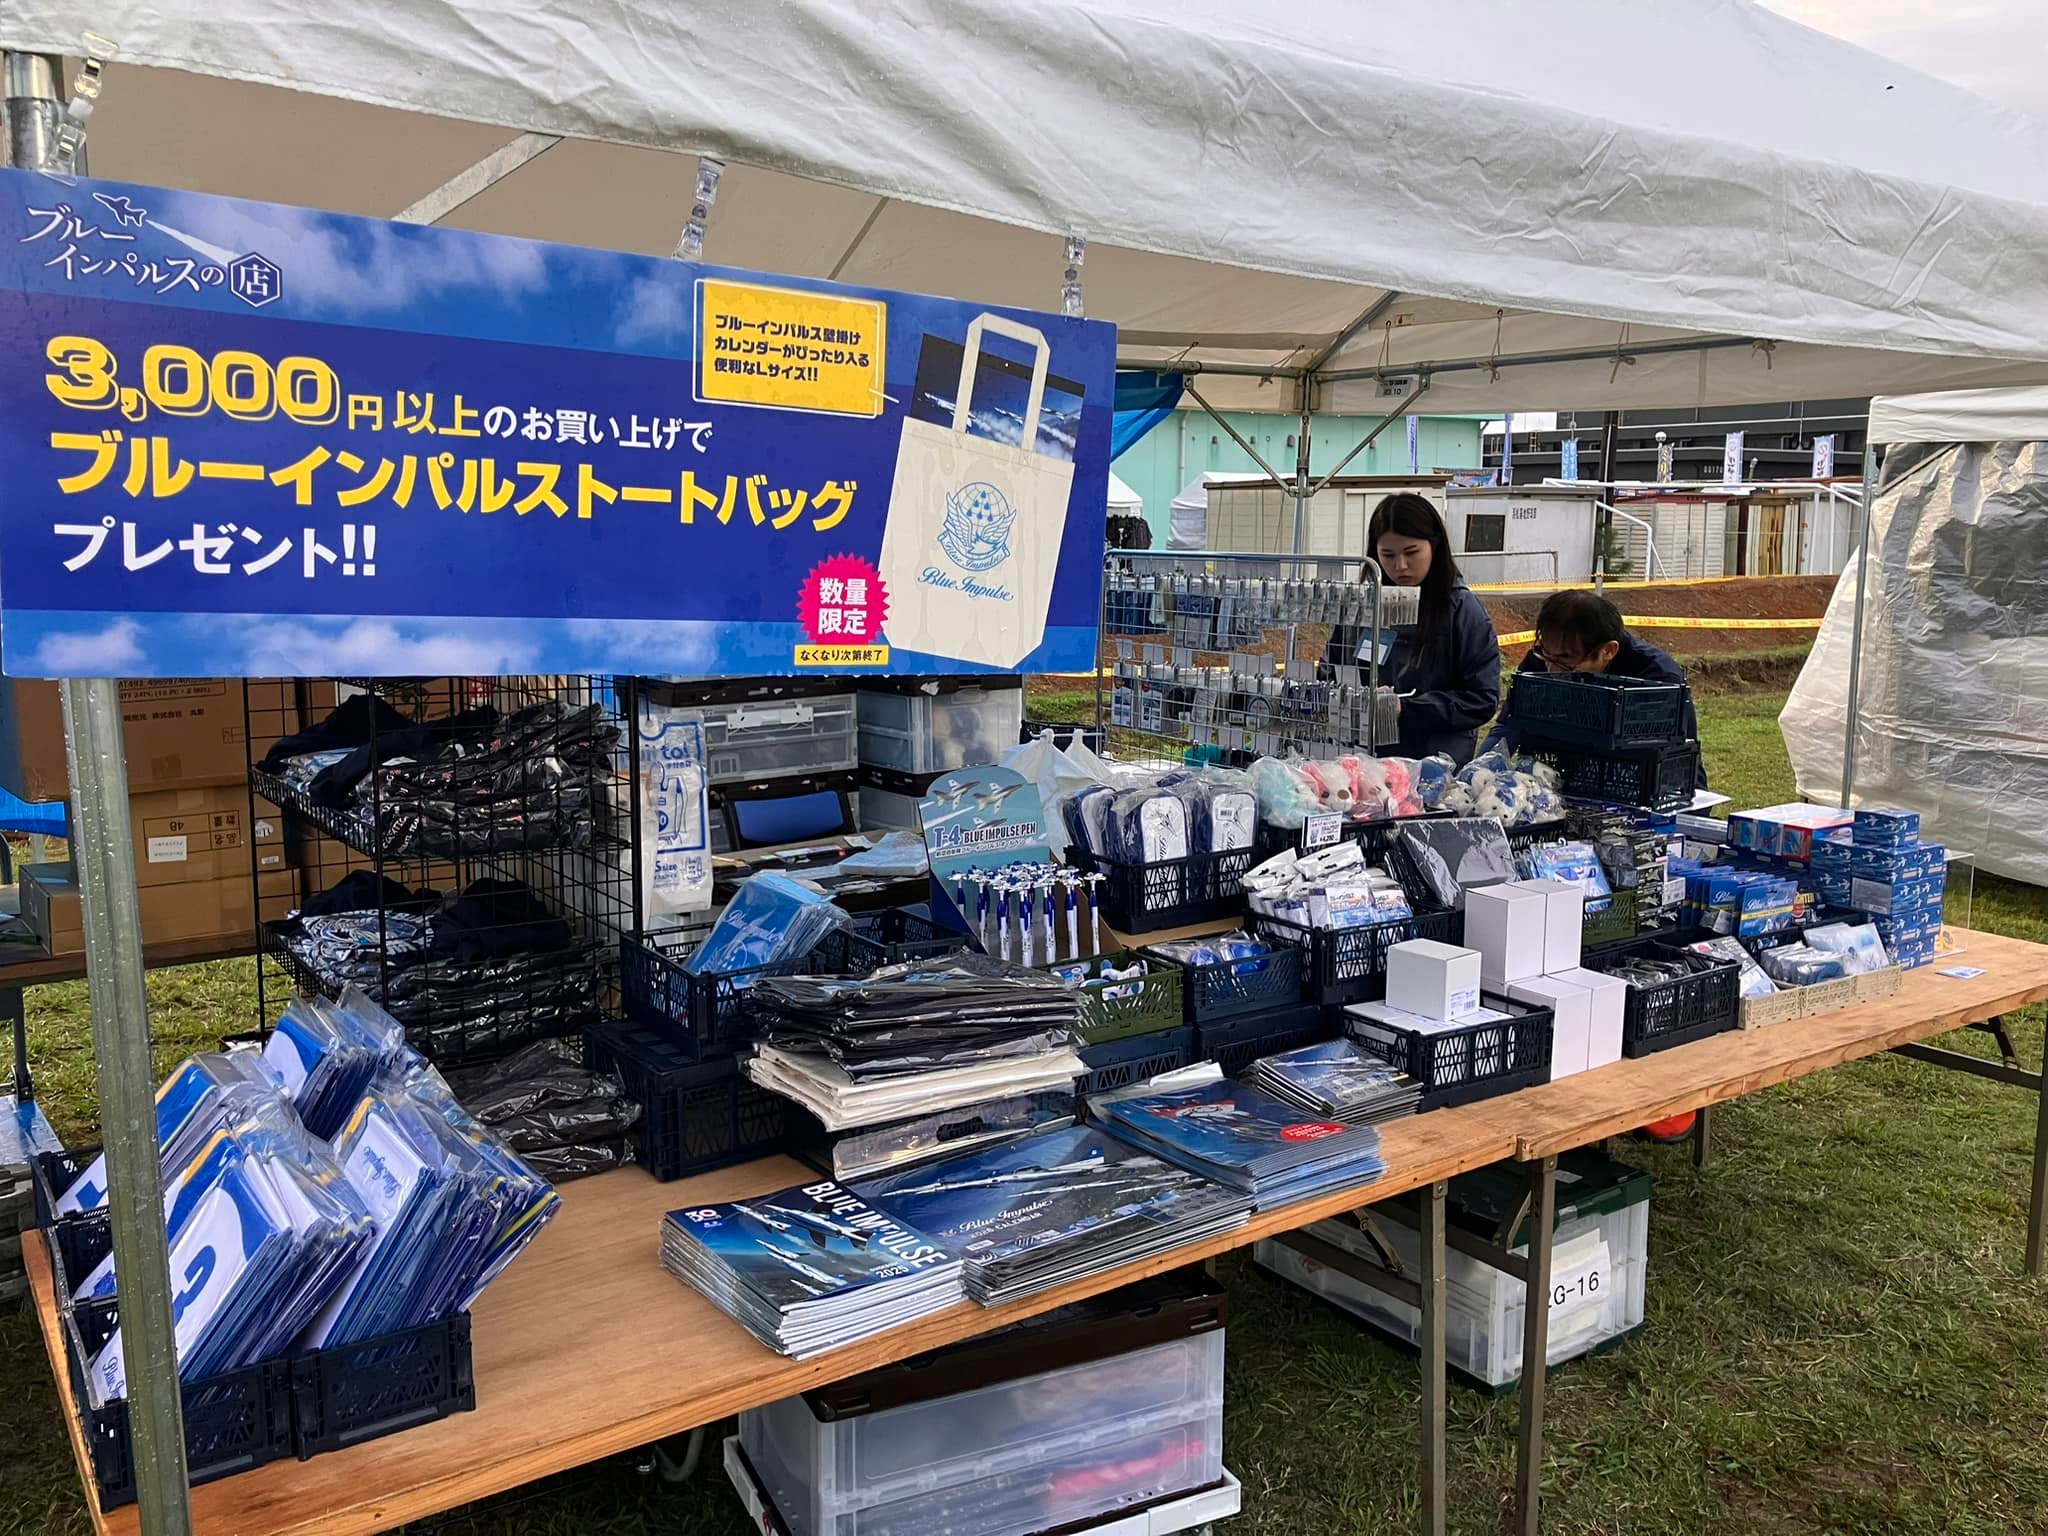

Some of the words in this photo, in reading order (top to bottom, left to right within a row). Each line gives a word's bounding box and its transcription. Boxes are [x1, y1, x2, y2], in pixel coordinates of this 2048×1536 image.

[20, 206, 135, 243] ブルー
[44, 241, 272, 298] インパルスの店
[715, 313, 862, 346] ブルーインパルス壁掛け
[50, 429, 858, 532] ブルーインパルストートバッグ
[53, 515, 378, 578] プレゼント!!
[819, 577, 869, 606] 数量
[917, 566, 957, 590] Blue
[954, 575, 1015, 601] Impulse
[817, 608, 868, 637] 限定
[799, 648, 884, 664] なくなり次第終了
[932, 824, 961, 849] T-4
[964, 829, 984, 844] BLUE
[985, 823, 1020, 841] IMPULSE
[1020, 821, 1037, 836] PEN
[959, 1216, 996, 1233] Blue
[994, 1198, 1054, 1222] Impulse
[875, 1265, 911, 1279] 2025
[1548, 1271, 1599, 1309] G-16
